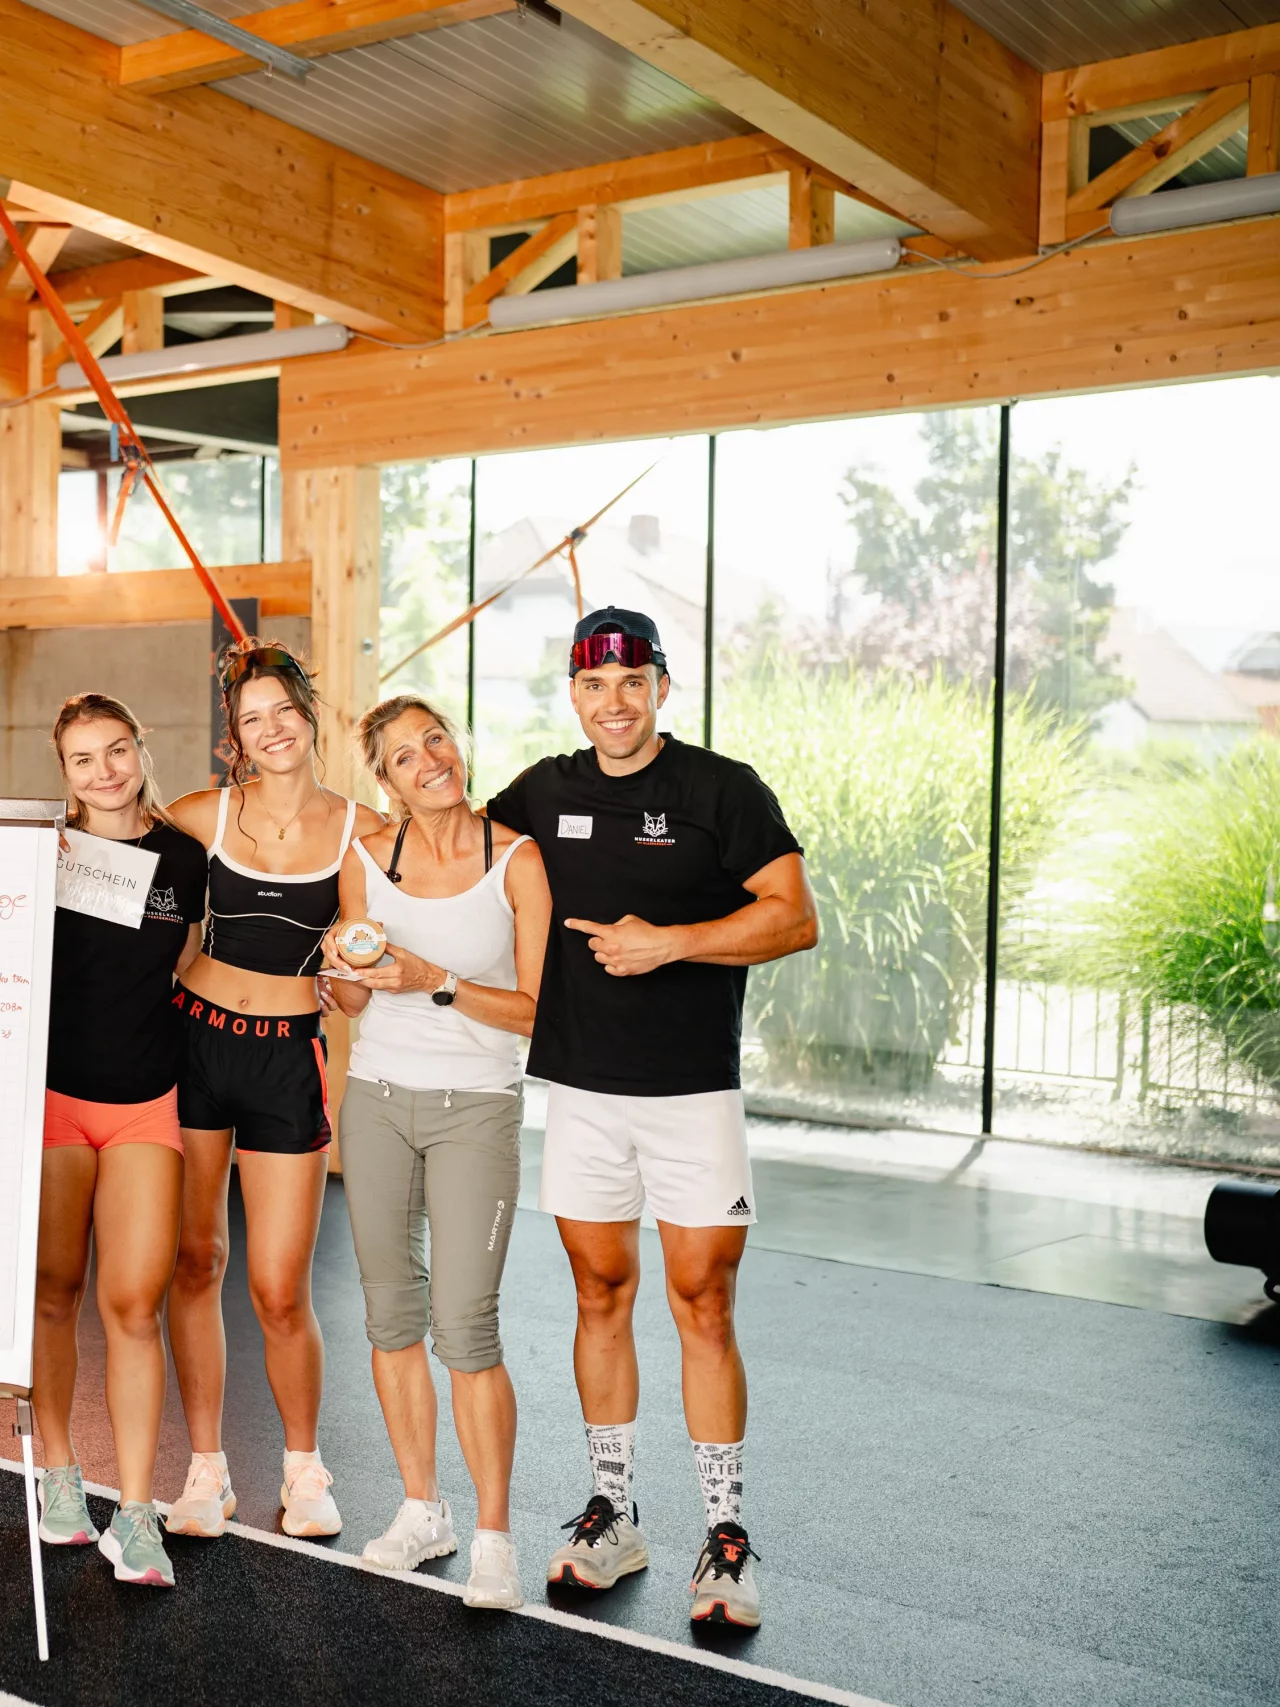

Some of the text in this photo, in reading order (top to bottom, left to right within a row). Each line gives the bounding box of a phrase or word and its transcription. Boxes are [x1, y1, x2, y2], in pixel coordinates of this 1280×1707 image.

[144, 911, 184, 921] USKELKATER
[171, 991, 291, 1038] ARMOUR
[727, 1207, 752, 1216] adidas
[487, 1209, 502, 1252] MARTINI
